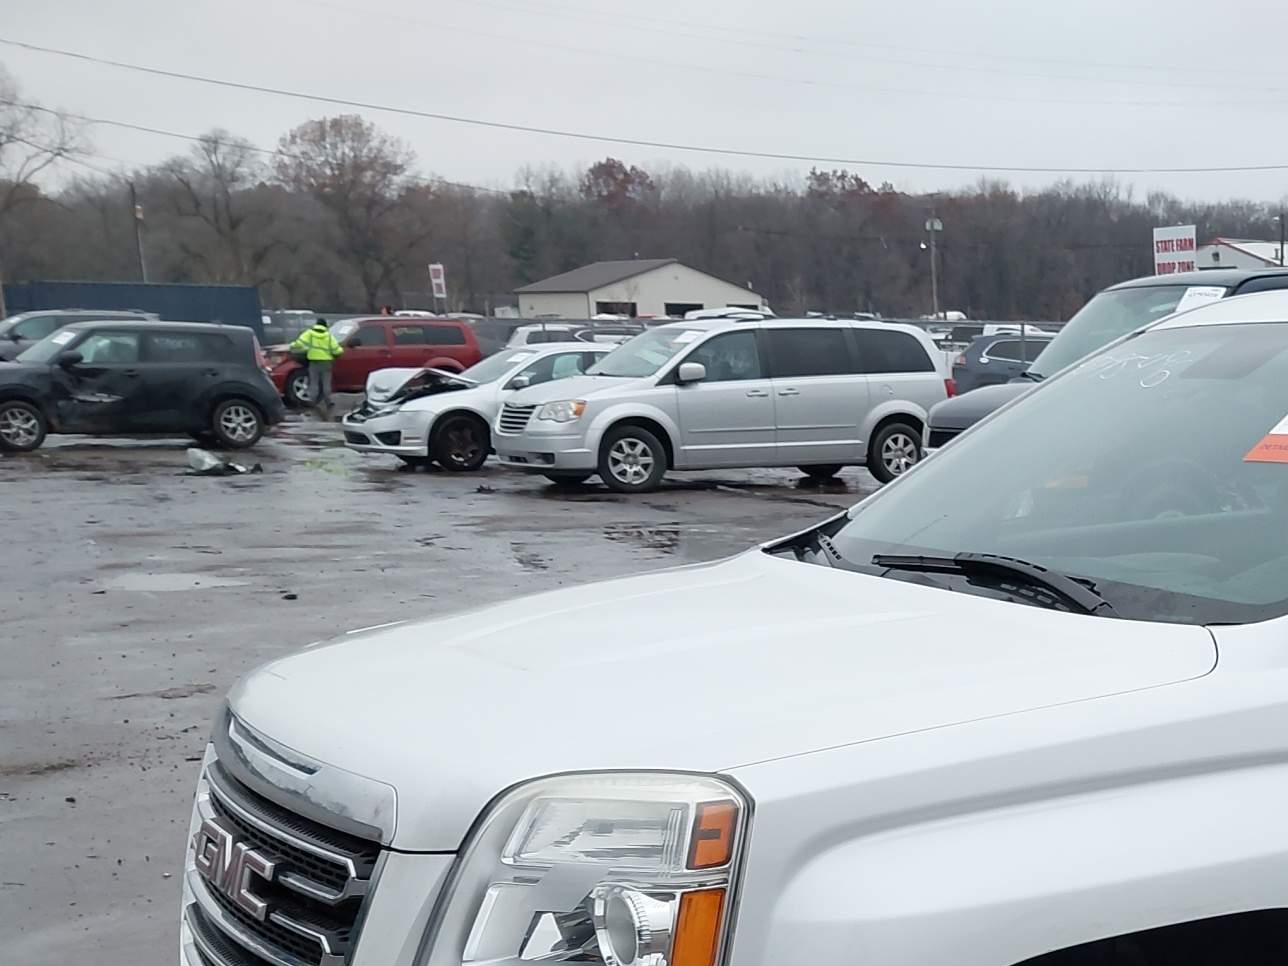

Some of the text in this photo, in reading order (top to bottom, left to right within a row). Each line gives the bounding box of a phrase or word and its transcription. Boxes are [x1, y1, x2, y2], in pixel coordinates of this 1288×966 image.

[1156, 238, 1194, 253] STATE FARM
[1157, 261, 1194, 275] DROP ZONE
[195, 818, 275, 921] GMC
